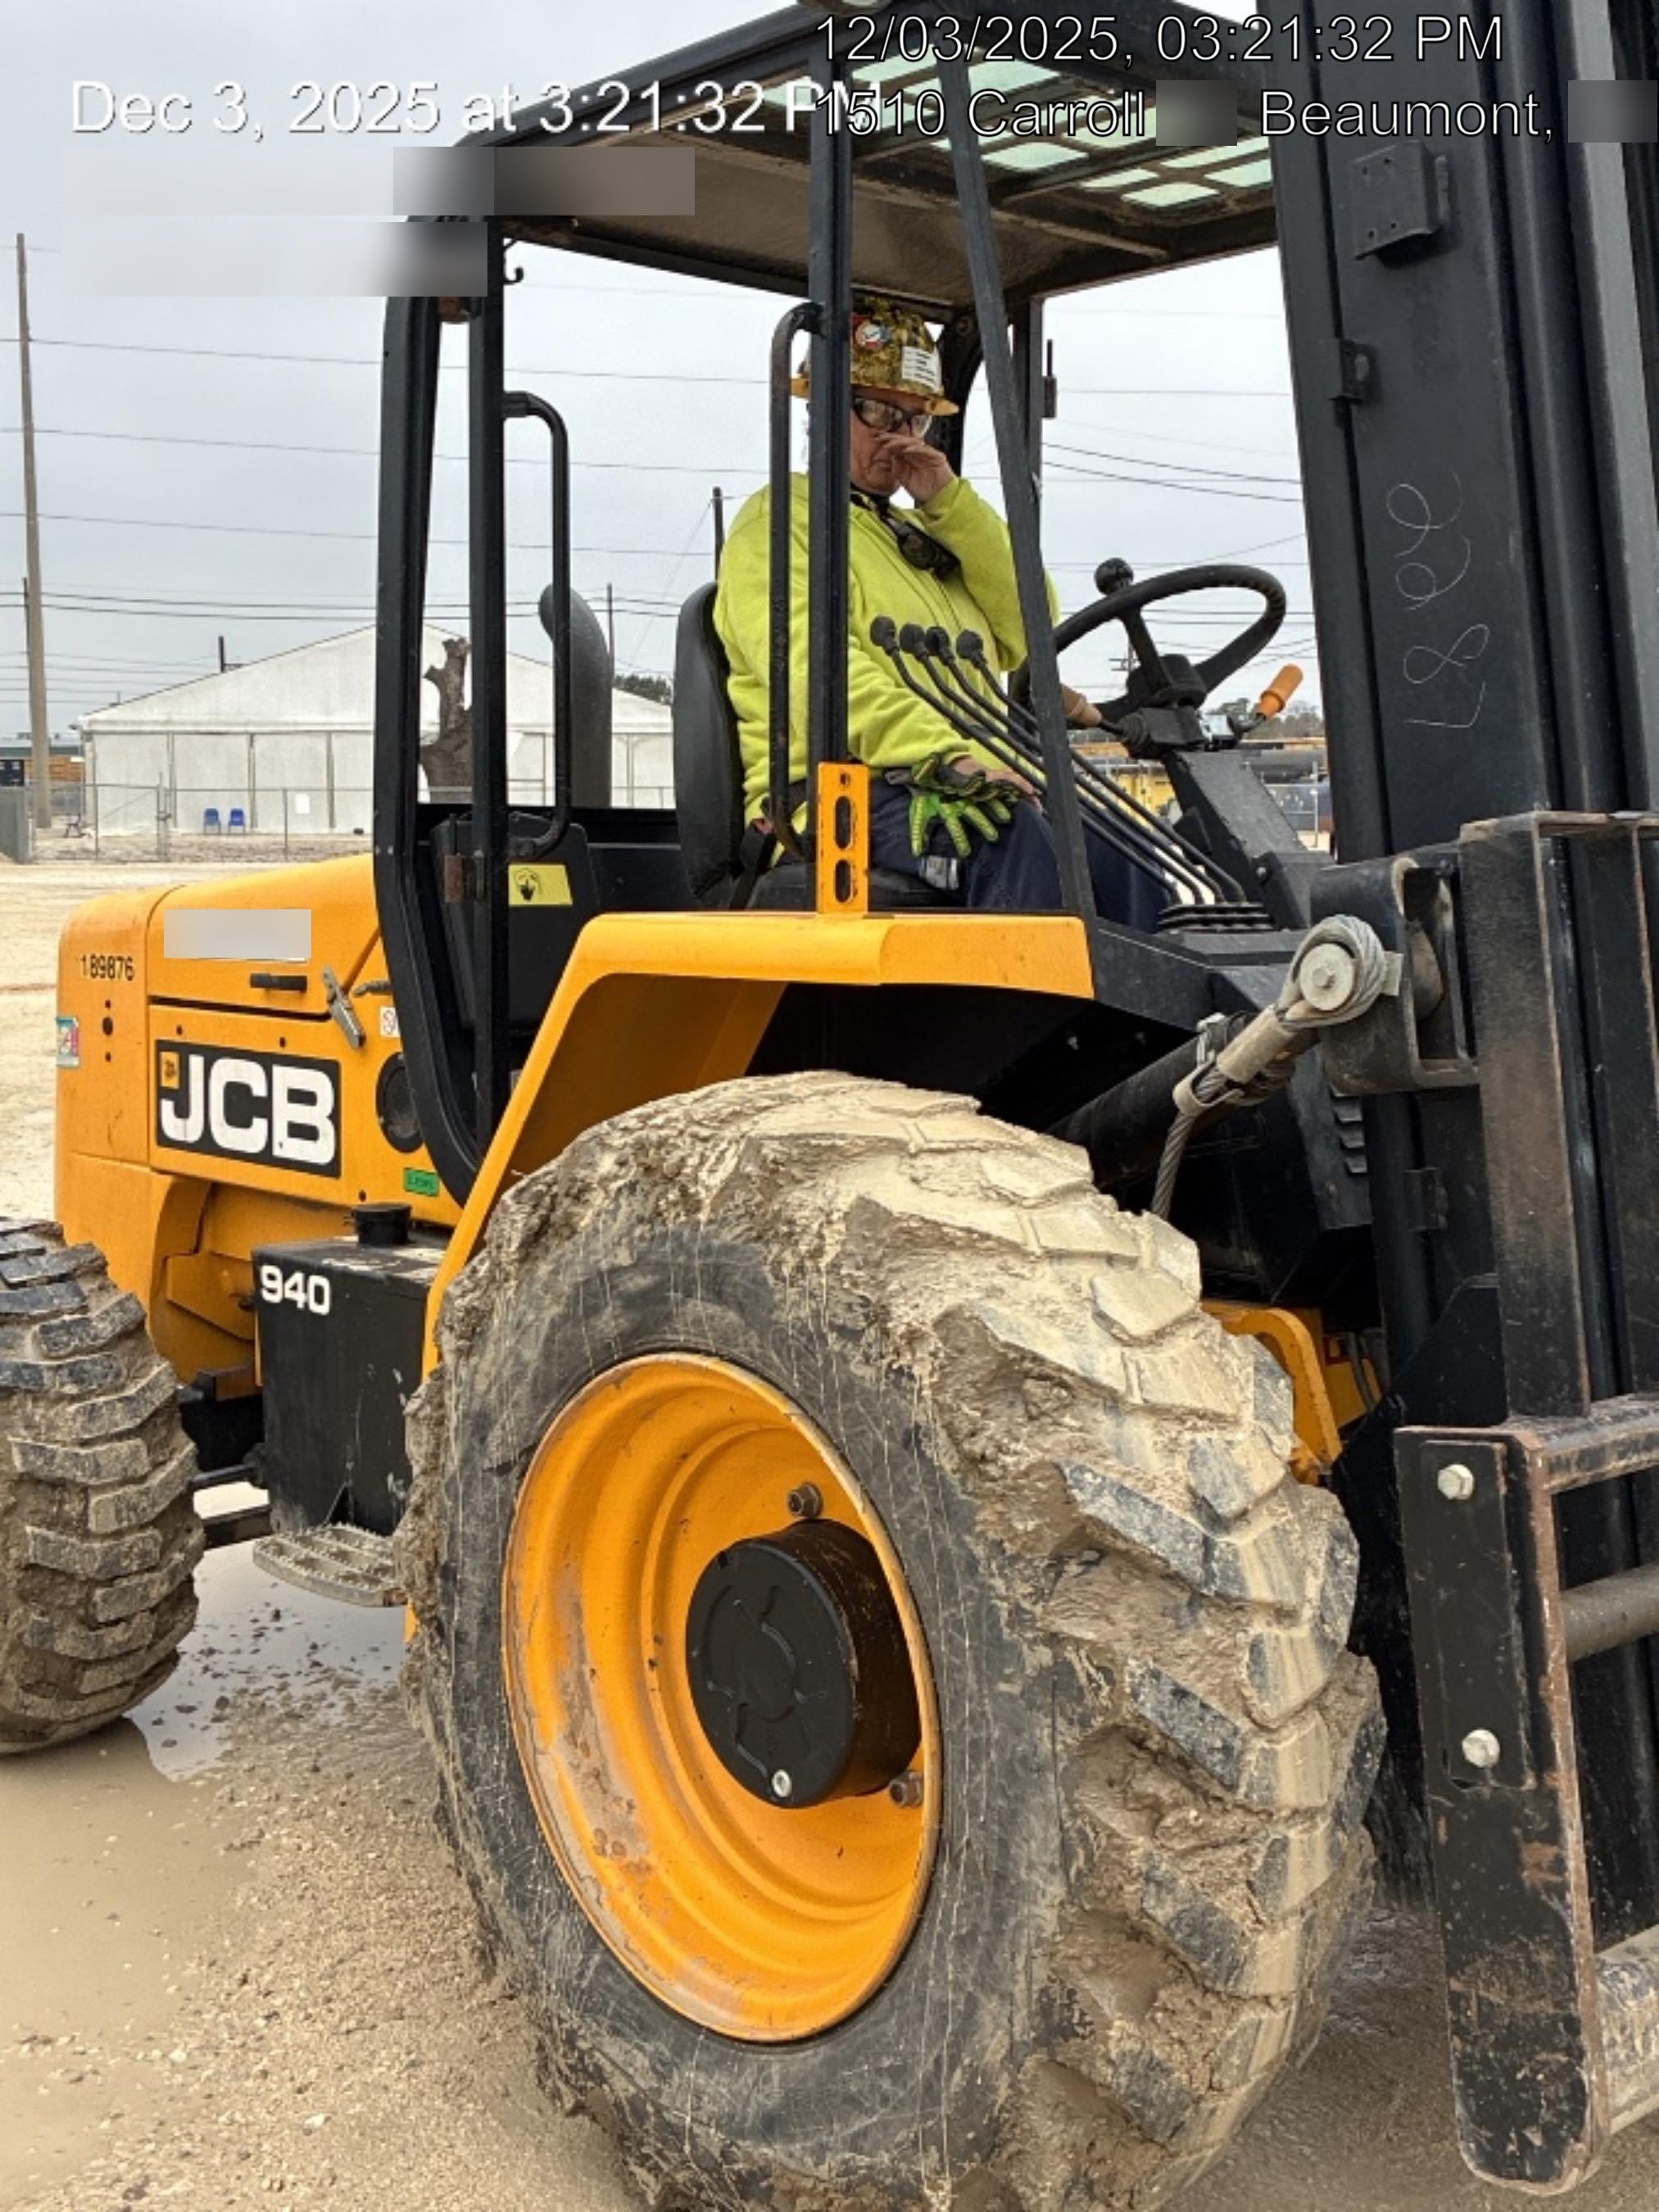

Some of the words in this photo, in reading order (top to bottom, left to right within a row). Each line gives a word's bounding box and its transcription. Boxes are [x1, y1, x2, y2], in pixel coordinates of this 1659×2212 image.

[80, 954, 135, 981] 189876
[161, 1054, 335, 1165] JCB
[260, 1266, 331, 1315] 940
